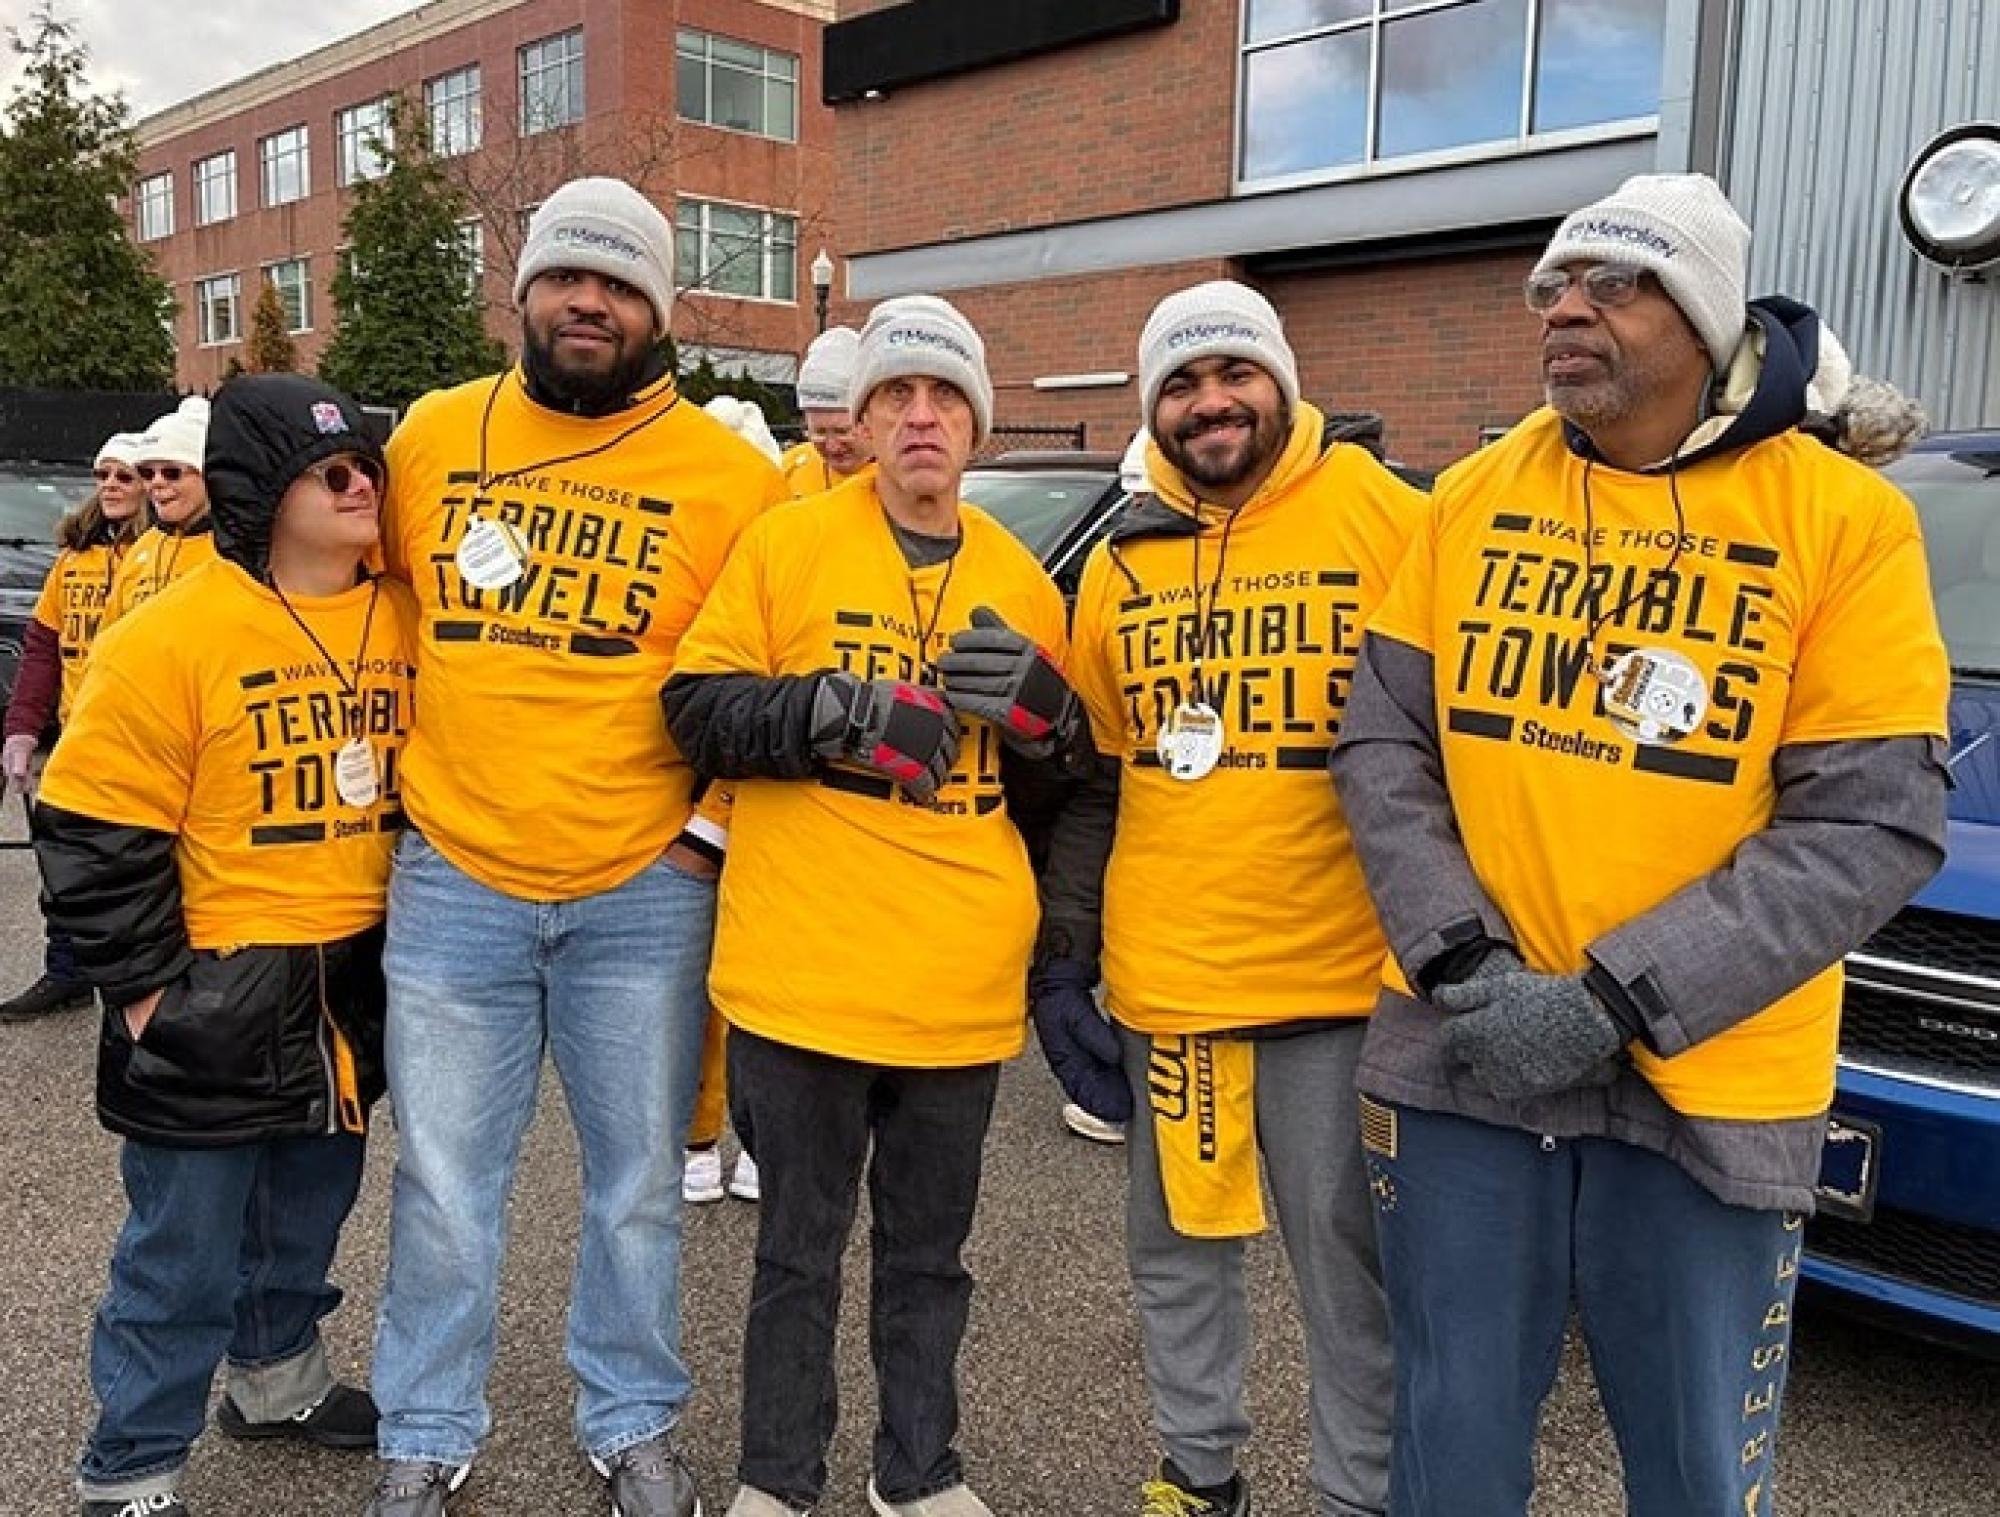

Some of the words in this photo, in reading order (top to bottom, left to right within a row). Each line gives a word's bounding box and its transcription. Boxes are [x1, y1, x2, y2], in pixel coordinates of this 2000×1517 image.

[559, 479, 633, 508] THOSE
[1618, 529, 1718, 557] THOSE
[1233, 571, 1313, 592] THOSE
[1475, 548, 1774, 652] TERRIBLE
[1117, 602, 1360, 674] TERRIBLE
[1457, 620, 1761, 742] TOWS
[1521, 718, 1623, 764] Steelers
